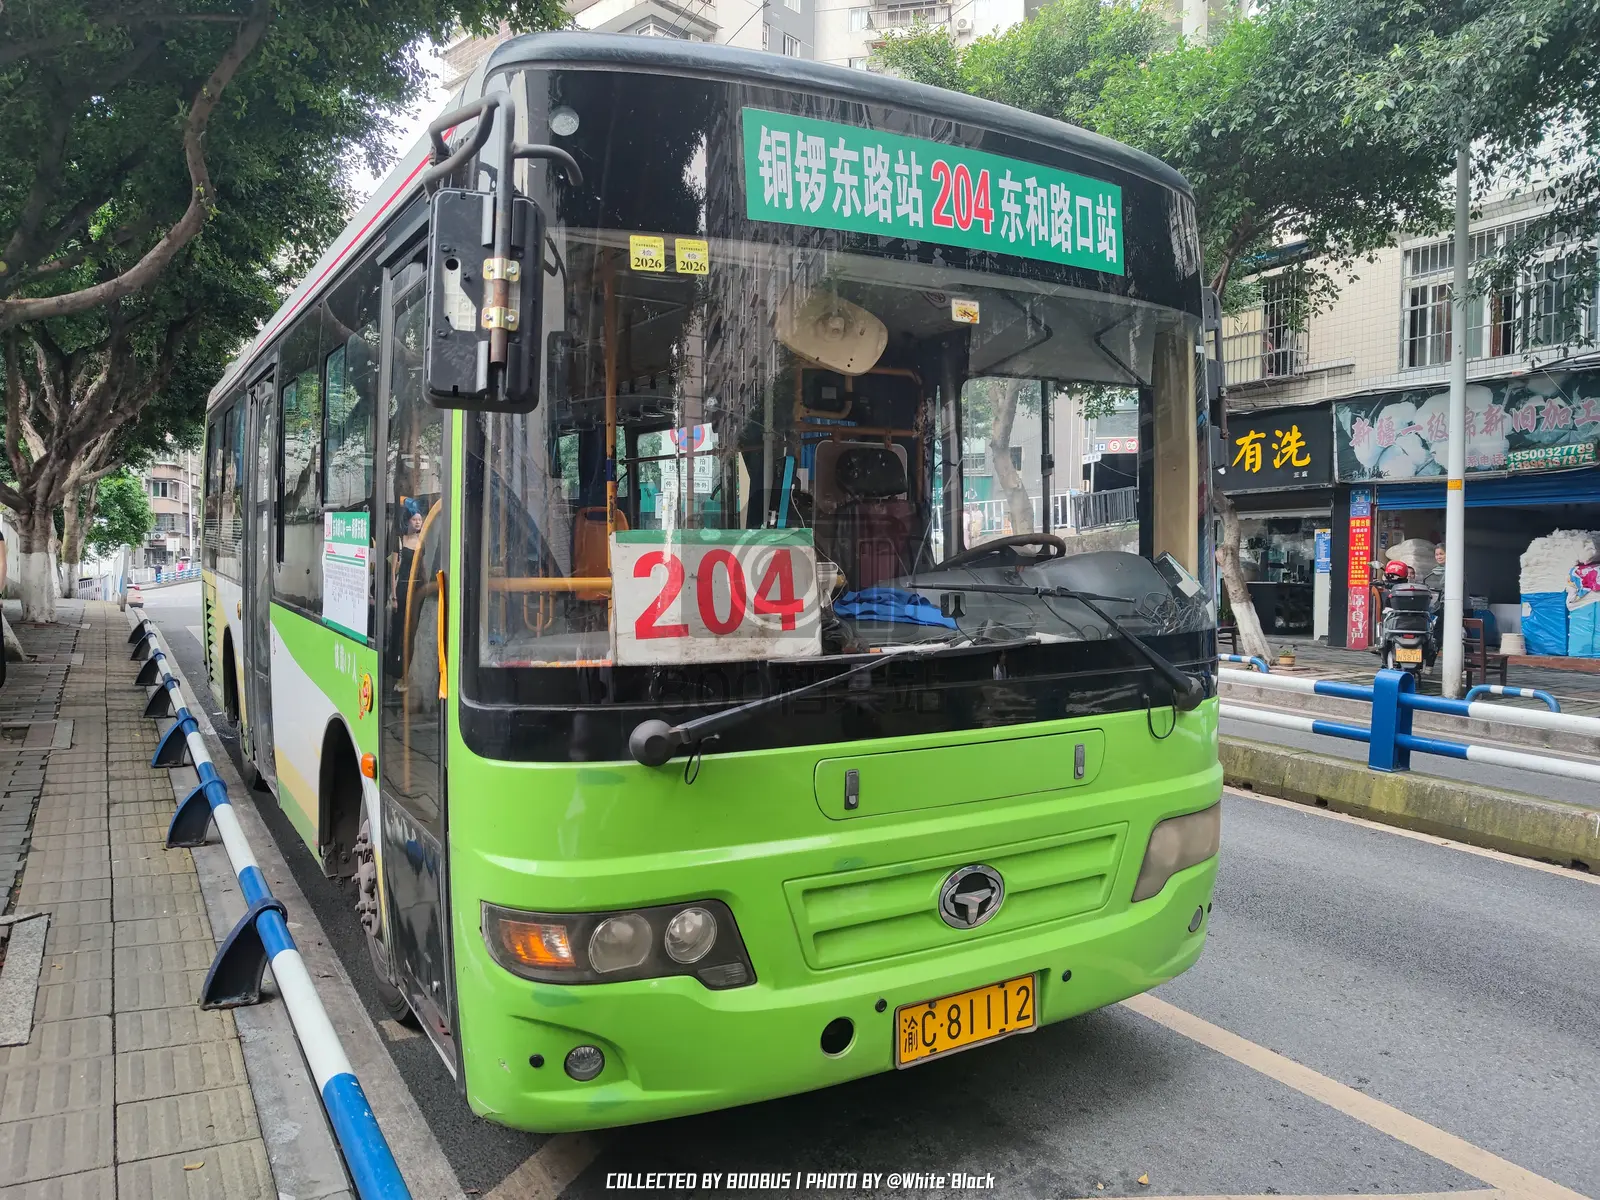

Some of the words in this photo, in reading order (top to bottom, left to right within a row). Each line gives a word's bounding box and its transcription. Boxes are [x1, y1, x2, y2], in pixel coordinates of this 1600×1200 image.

[758, 124, 923, 228] 铜锣东路站
[930, 159, 994, 235] 204
[998, 168, 1117, 264] 东和路口站
[634, 257, 662, 269] 2026
[680, 260, 706, 272] 2026
[1232, 425, 1311, 473] 有洗
[1508, 443, 1594, 461] 13500327789
[633, 549, 804, 640] 204
